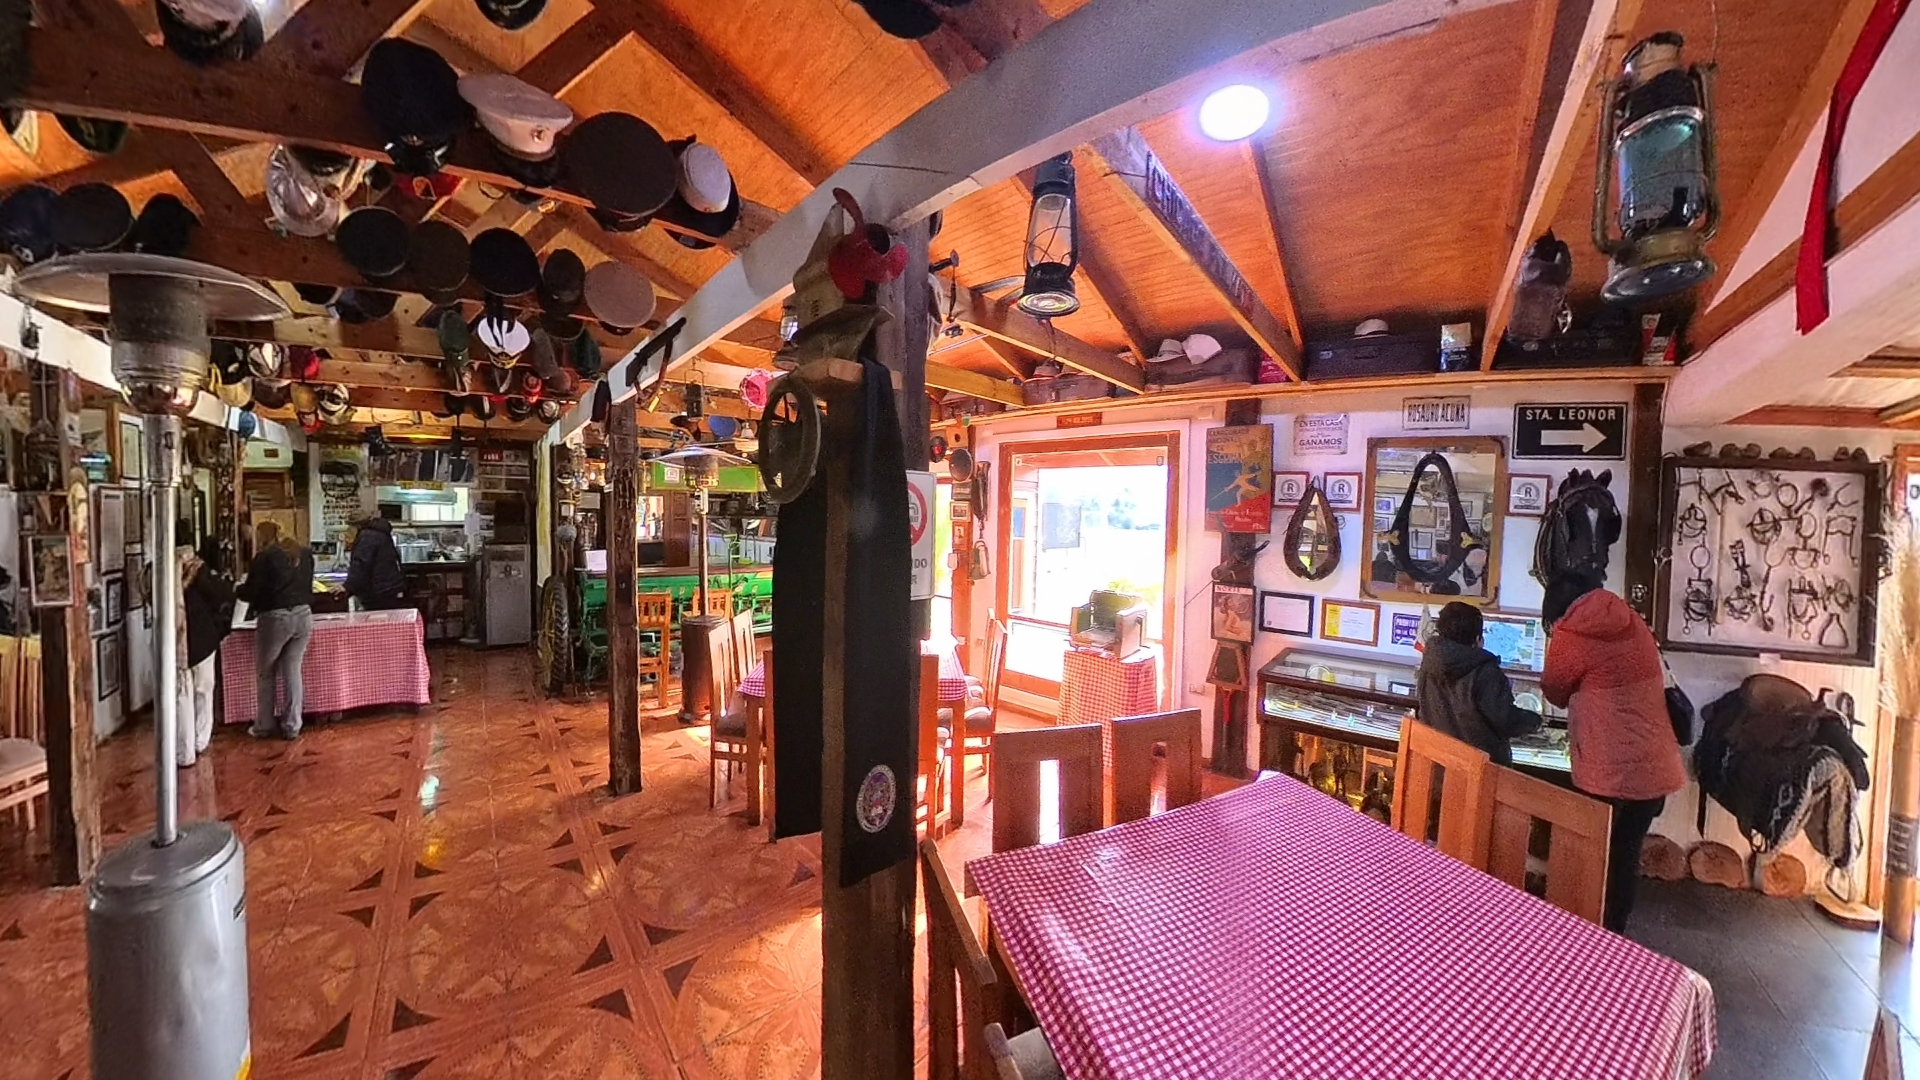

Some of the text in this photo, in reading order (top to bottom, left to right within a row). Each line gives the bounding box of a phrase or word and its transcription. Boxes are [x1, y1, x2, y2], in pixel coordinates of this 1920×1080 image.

[1408, 403, 1440, 422] ROSAURO
[1525, 408, 1616, 421] STA. LEONOR
[1298, 438, 1343, 446] GANAMOS
